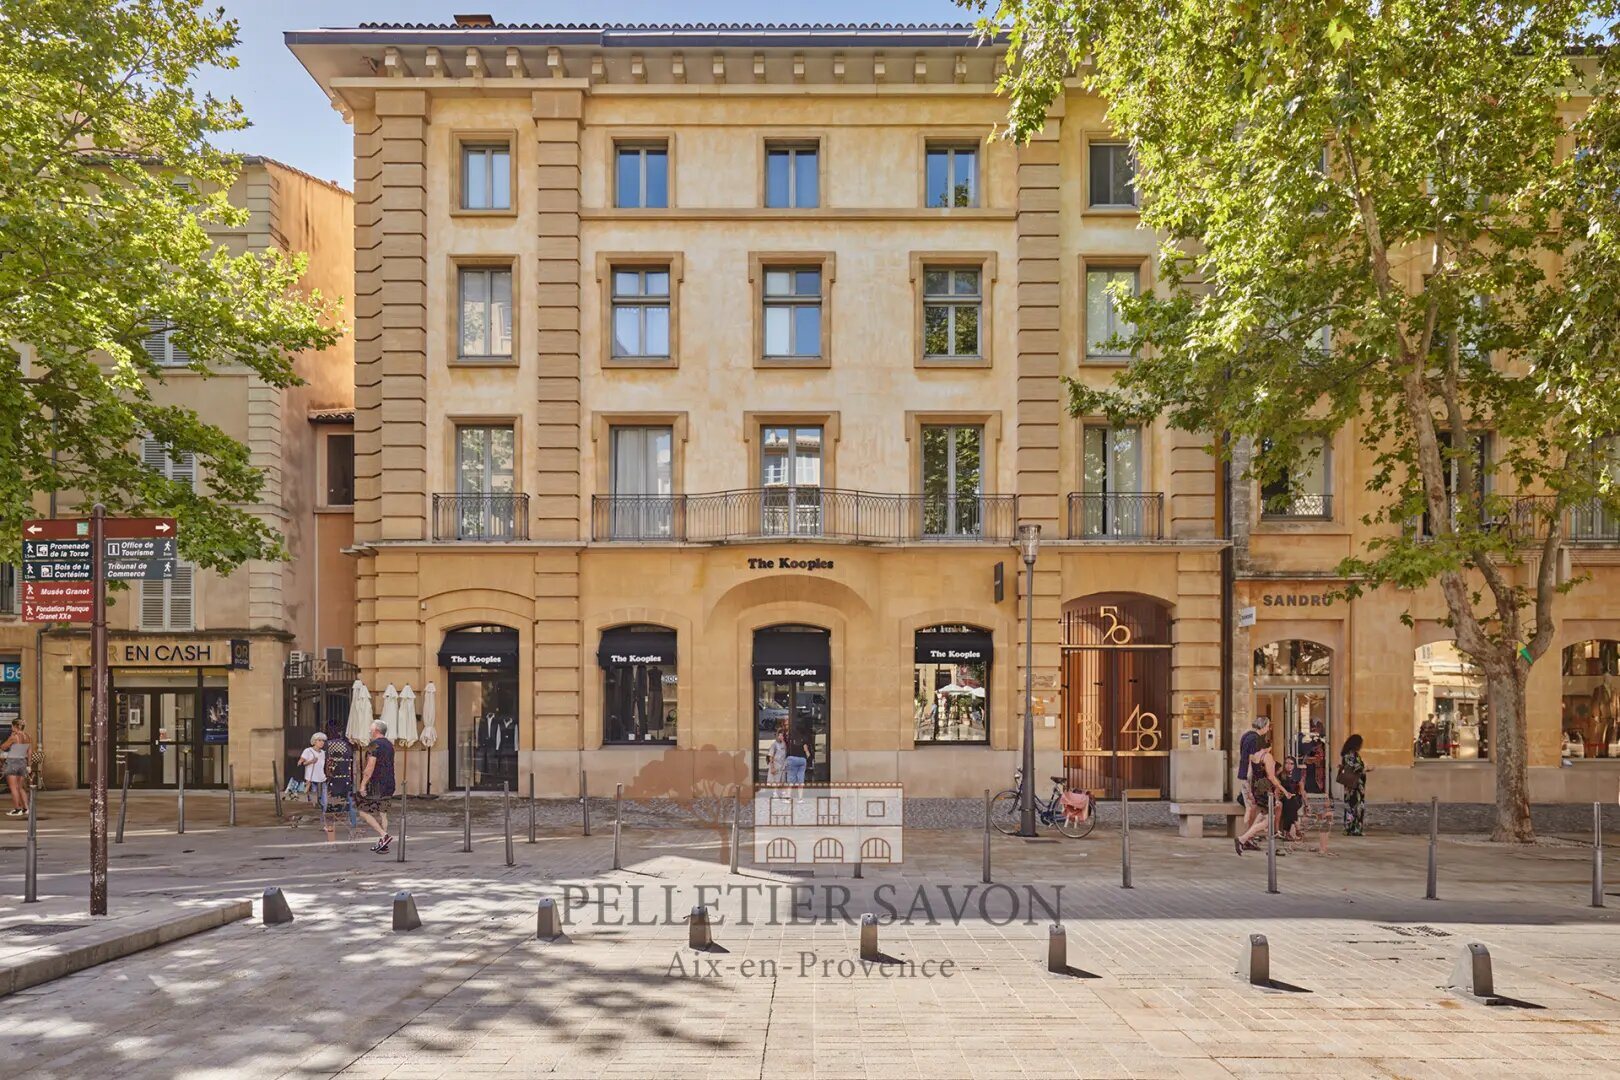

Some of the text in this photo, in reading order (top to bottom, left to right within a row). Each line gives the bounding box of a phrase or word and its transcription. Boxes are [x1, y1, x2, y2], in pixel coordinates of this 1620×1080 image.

[748, 558, 834, 571] The Kooples
[66, 606, 90, 614] Planque
[1100, 606, 1131, 644] 50
[125, 645, 149, 661] EN
[155, 645, 211, 661] CASH
[948, 650, 980, 659] Kooples
[469, 656, 501, 664] Kooples
[629, 655, 661, 663] Kooples
[784, 668, 816, 676] Kooples
[1120, 704, 1162, 751] 48
